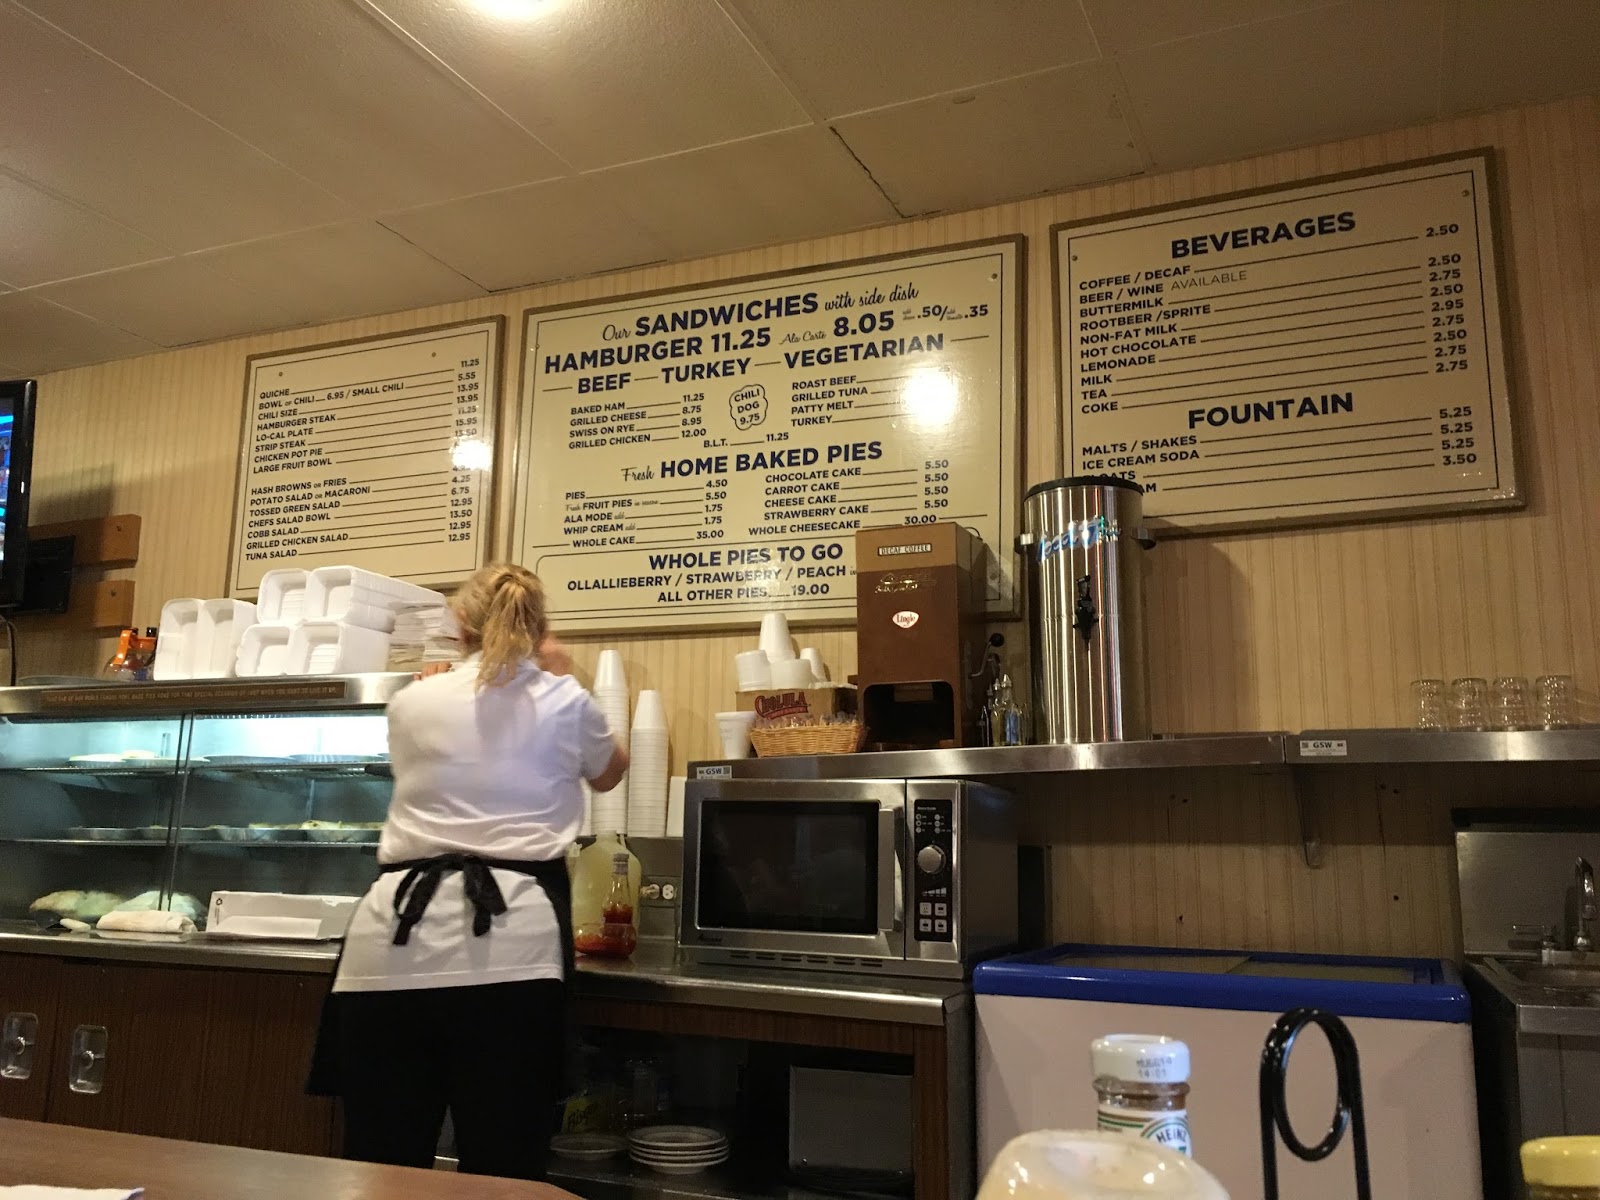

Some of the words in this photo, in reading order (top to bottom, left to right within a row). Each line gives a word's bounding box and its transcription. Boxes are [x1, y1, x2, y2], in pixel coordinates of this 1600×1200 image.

[1171, 211, 1356, 259] BEVERAGES
[1079, 274, 1130, 291] COFFEE
[1145, 266, 1191, 281] DECAF
[1426, 224, 1459, 237] 2.50
[1080, 297, 1164, 317] BUTTERMILK
[1428, 253, 1461, 267] 2.50
[1080, 291, 1113, 304] BEER
[1127, 283, 1164, 297] WINE
[1171, 270, 1247, 291] AVAILABLE
[1080, 314, 1152, 331] ROOTBEER
[1429, 269, 1460, 282] 2.75
[603, 324, 631, 341] Our
[635, 292, 819, 337] SANDWICHES
[825, 292, 855, 311] with
[859, 288, 885, 306] side
[889, 282, 918, 301] dish
[1080, 328, 1141, 345] NON-FAT
[1145, 323, 1178, 336] MILK
[1431, 283, 1463, 297] 2.50
[545, 337, 703, 374] HAMBURGER
[711, 327, 771, 352] 11.25
[834, 310, 894, 337] 8.05
[1081, 355, 1156, 373] LEMONADE
[1433, 314, 1464, 327] 2.75
[1081, 347, 1108, 359] HOT
[1112, 335, 1196, 355] CHOCOLATE
[578, 372, 631, 394] BEEF
[662, 357, 751, 384] TURKEY
[784, 333, 944, 369] VEGETARIAN
[1082, 389, 1107, 400] TEA
[1435, 344, 1466, 357] 2.75
[792, 379, 827, 390] ROAST
[830, 375, 856, 386] BEEF
[1081, 374, 1112, 386] MILK
[259, 400, 283, 410] BOWL
[294, 396, 315, 405] CHILI
[352, 387, 380, 397] SMALL
[382, 383, 404, 392] CHILI
[260, 389, 290, 399] QUICHE
[734, 389, 760, 402] CHILI
[791, 390, 835, 403] GRILLED
[838, 386, 868, 397] TUNA
[571, 405, 603, 415] BAKED
[604, 402, 625, 412] HAM
[683, 393, 705, 402] 11.25
[737, 401, 760, 413] DOG
[791, 403, 822, 415] PATTY
[827, 401, 854, 410] MELT
[1082, 401, 1118, 414] COKE
[1188, 392, 1353, 430] FOUNTAIN
[257, 417, 307, 431] HAMBURGER
[309, 414, 336, 424] STEAK
[258, 411, 279, 420] CHILI
[281, 409, 297, 417] SIZE
[570, 416, 608, 427] GRILLED
[610, 411, 646, 422] CHEESE
[682, 405, 702, 414] 8.75
[740, 413, 760, 425] 9.75
[791, 415, 833, 427] TURKEY
[256, 432, 286, 441] LO-CAL
[288, 428, 313, 438] PLATE
[569, 428, 598, 438] SWISS
[600, 426, 614, 434] ON
[617, 424, 635, 433] RYE
[569, 438, 607, 449] GRILLED
[609, 434, 651, 446] CHICKEN
[682, 428, 706, 438] 12.00
[703, 438, 728, 448] B.L.T.
[766, 432, 789, 442] 11.25
[1082, 442, 1127, 456] MALTS
[1142, 435, 1197, 450] SHAKES
[1440, 406, 1472, 419] 5.25
[255, 443, 278, 452] STRIP
[279, 440, 306, 449] STEAK
[254, 452, 289, 463] CHICKEN
[291, 450, 308, 459] POT
[310, 448, 322, 456] PIE
[621, 466, 654, 482] Fresh
[661, 456, 728, 478] HOME
[735, 447, 819, 471] BAKED
[828, 441, 882, 463] PIES
[1083, 460, 1103, 470] ICE
[1108, 454, 1155, 467] CREAM
[1160, 450, 1199, 462] SODA
[253, 464, 280, 474] LARGE
[282, 461, 305, 471] FRUIT
[307, 459, 332, 468] BOWL
[766, 471, 829, 482] CHOCOLATE
[832, 467, 861, 477] CAKE
[251, 487, 273, 495] HASH
[275, 482, 312, 493] BROWNS
[323, 478, 346, 488] FRIES
[566, 491, 586, 500] PIES
[706, 479, 728, 488] 4.50
[765, 484, 808, 495] CARROT
[811, 482, 840, 492] CAKE
[250, 495, 284, 506] POTATO
[286, 492, 313, 502] SALAD
[325, 486, 370, 498] MACARONI
[583, 501, 609, 510] FRUIT
[612, 499, 632, 508] PIES
[706, 491, 726, 500] 5.50
[765, 497, 805, 508] CHEESE
[808, 495, 836, 504] CAKE
[925, 486, 949, 495] 5.50
[250, 506, 281, 517] TOSSED
[283, 504, 310, 513] GREEN
[312, 501, 340, 511] SALAD
[564, 514, 583, 523] ALA
[585, 512, 612, 521] MODE
[705, 504, 723, 513] 1.75
[764, 507, 836, 521] STRAWBERRY
[840, 505, 869, 515] CAKE
[924, 499, 948, 508] 5.50
[248, 518, 274, 528] CHEFS
[276, 515, 303, 525] SALAD
[305, 513, 331, 522] BOWL
[564, 525, 588, 535] WHIP
[590, 523, 623, 533] CREAM
[749, 525, 786, 535] WHOLE
[790, 520, 860, 533] CHEESECAKE
[904, 515, 937, 524] 30.00
[247, 539, 280, 550] GRILLED
[282, 536, 318, 546] CHICKEN
[320, 533, 348, 543] SALAD
[248, 530, 270, 539] COBB
[272, 527, 299, 536] SALAD
[573, 538, 607, 548] WHOLE
[609, 536, 635, 545] CAKE
[696, 530, 724, 540] 35.00
[246, 552, 267, 561] TUNA
[269, 549, 297, 558] SALAD
[649, 551, 721, 570] WHOLE
[727, 547, 772, 565] PIES
[777, 546, 806, 562] TO
[811, 543, 843, 560] GO
[567, 575, 672, 591] OLLALLIEBERRY
[686, 568, 782, 584] STRAWBERRY
[797, 565, 846, 578] PEACH
[658, 591, 682, 602] ALL
[687, 588, 733, 601] OTHER
[737, 586, 767, 598] PIES
[791, 584, 830, 596] 19.00
